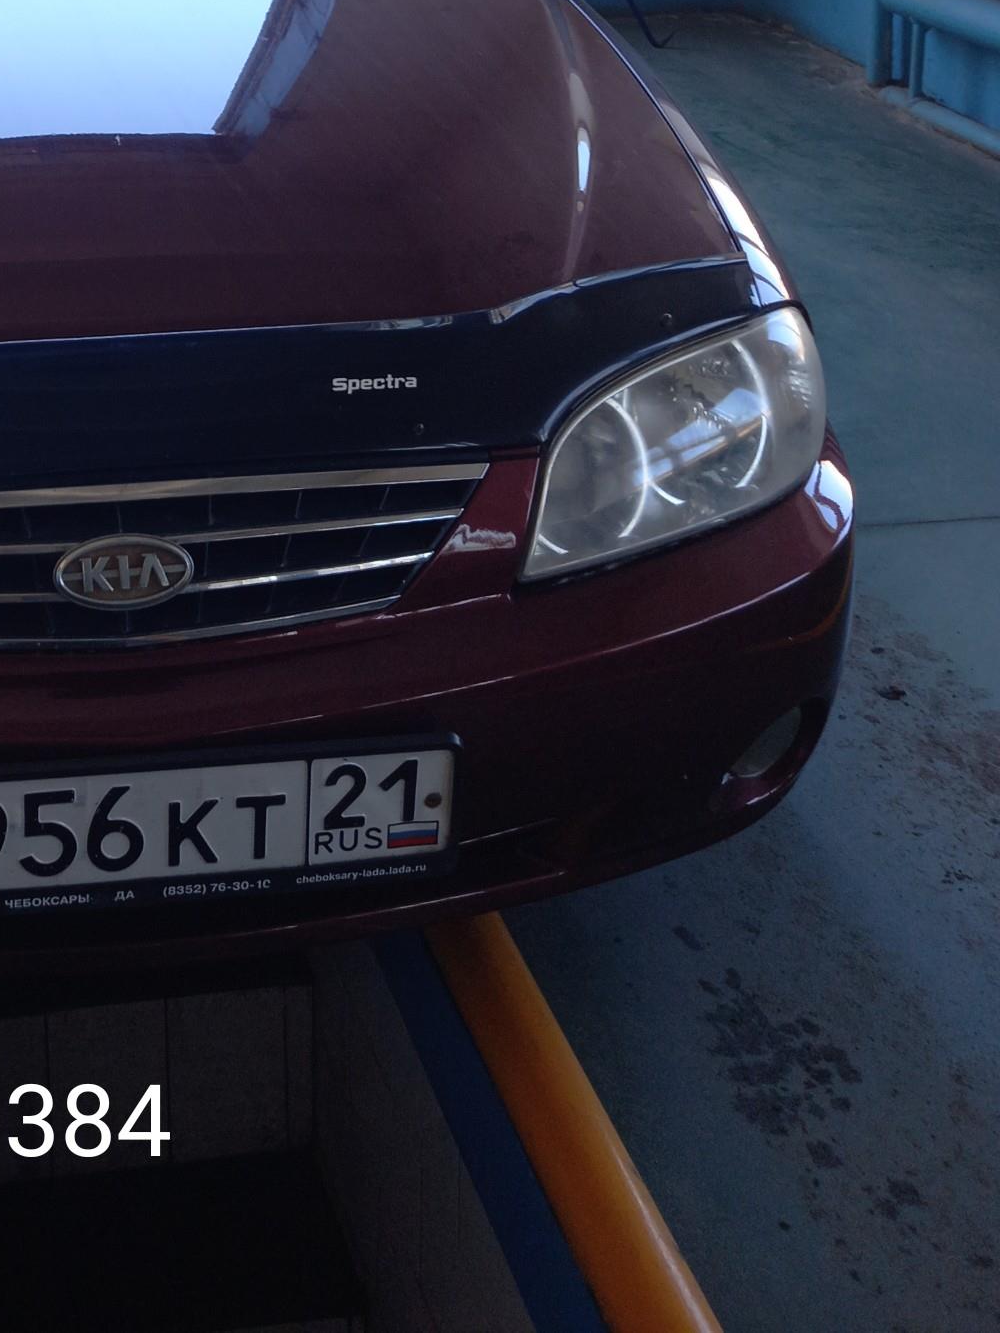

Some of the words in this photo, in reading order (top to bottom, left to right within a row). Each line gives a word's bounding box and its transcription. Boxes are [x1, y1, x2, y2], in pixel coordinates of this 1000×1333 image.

[332, 374, 418, 394] Spectra
[79, 552, 169, 593] KIA
[322, 758, 421, 830] 21
[314, 828, 383, 855] RUS
[295, 864, 427, 884] cheboksary-lada.lada.ru
[162, 883, 207, 898] (8352)
